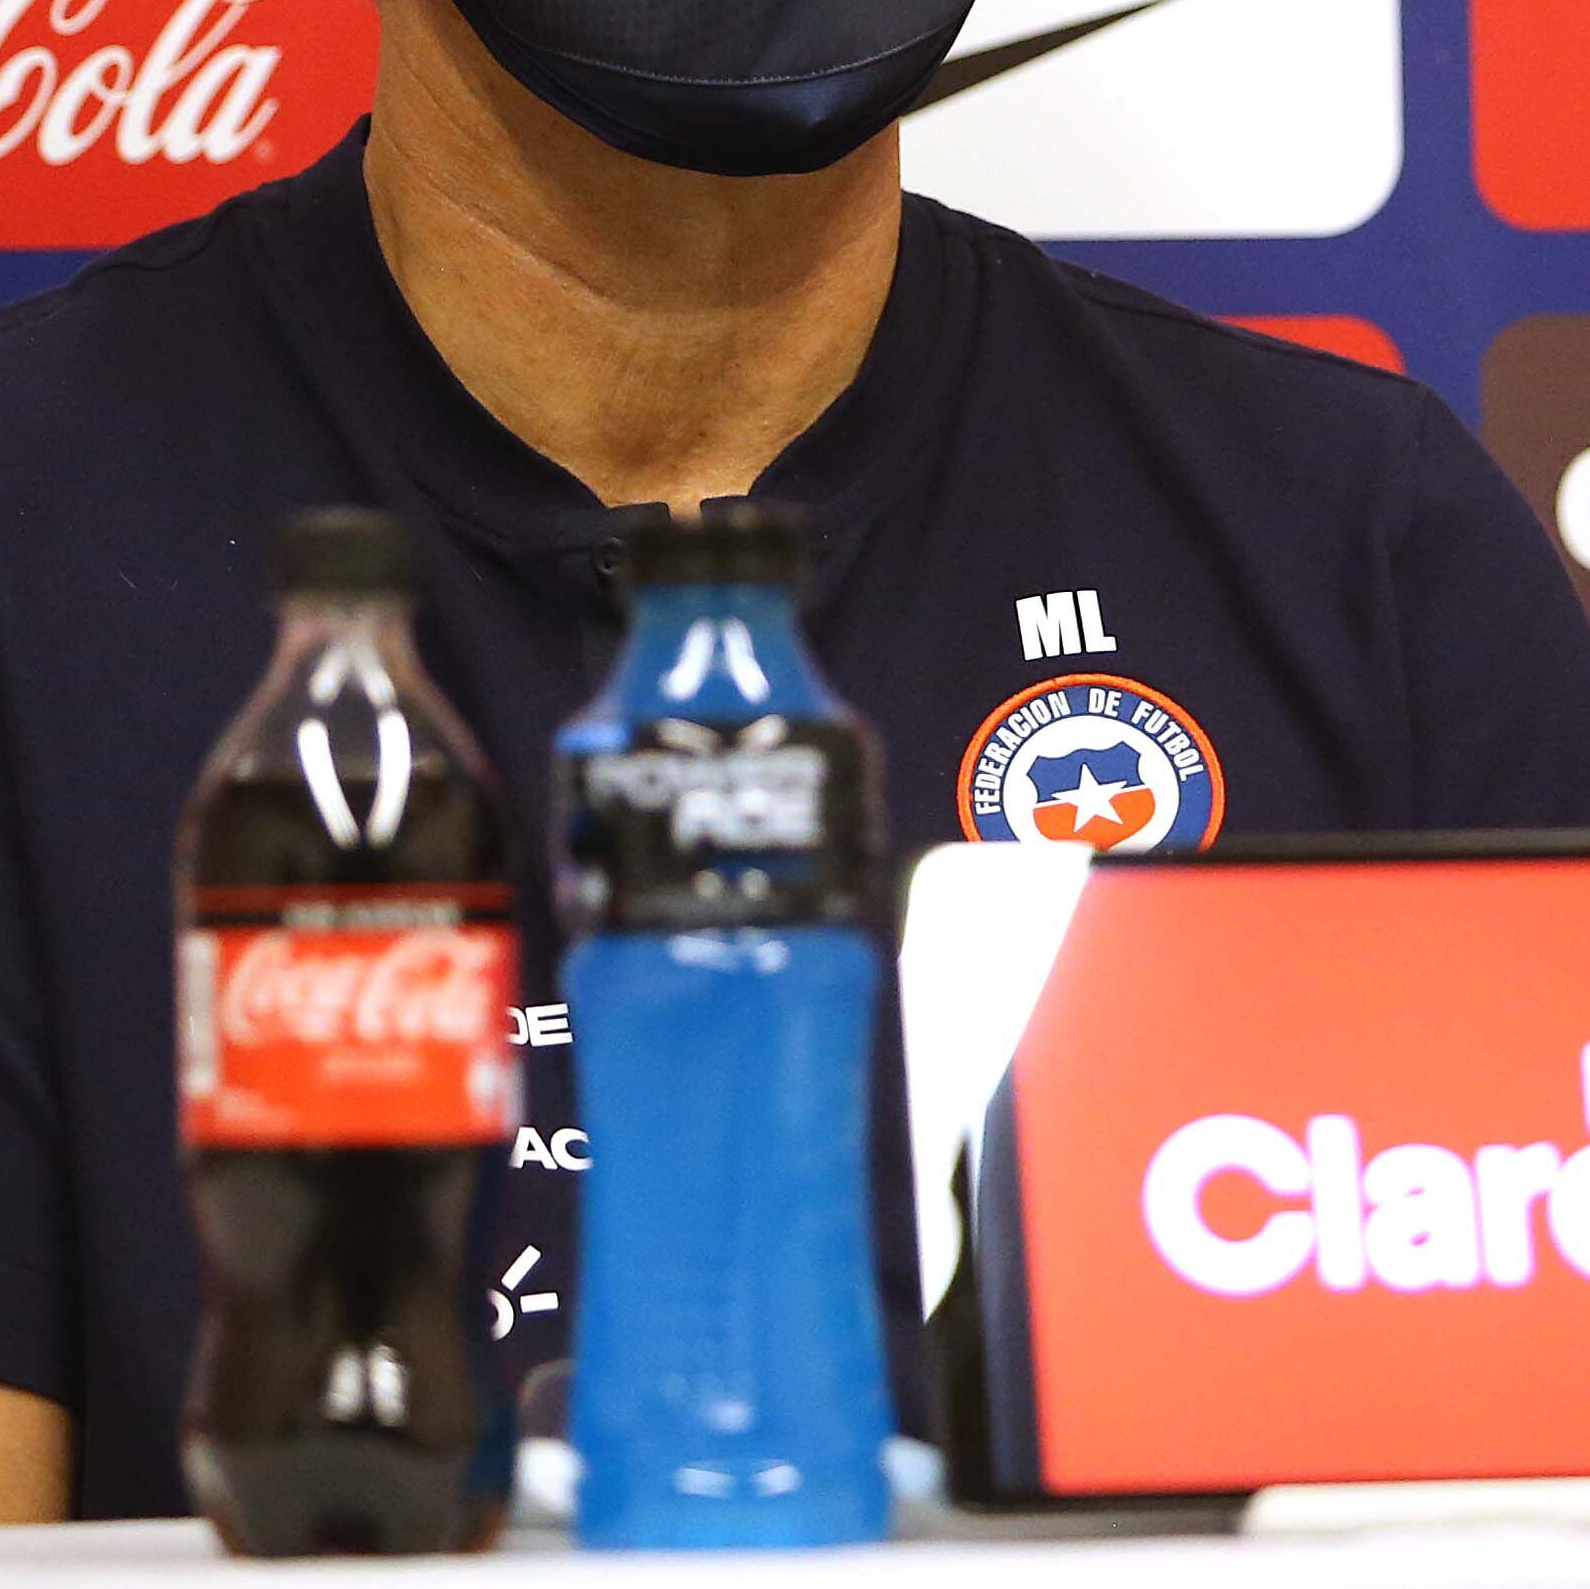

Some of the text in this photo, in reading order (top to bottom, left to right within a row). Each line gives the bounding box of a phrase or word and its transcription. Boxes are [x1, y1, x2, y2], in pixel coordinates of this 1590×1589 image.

[1015, 589, 1117, 661] ML
[974, 688, 1205, 815] FEDERACION DE FUTBOL
